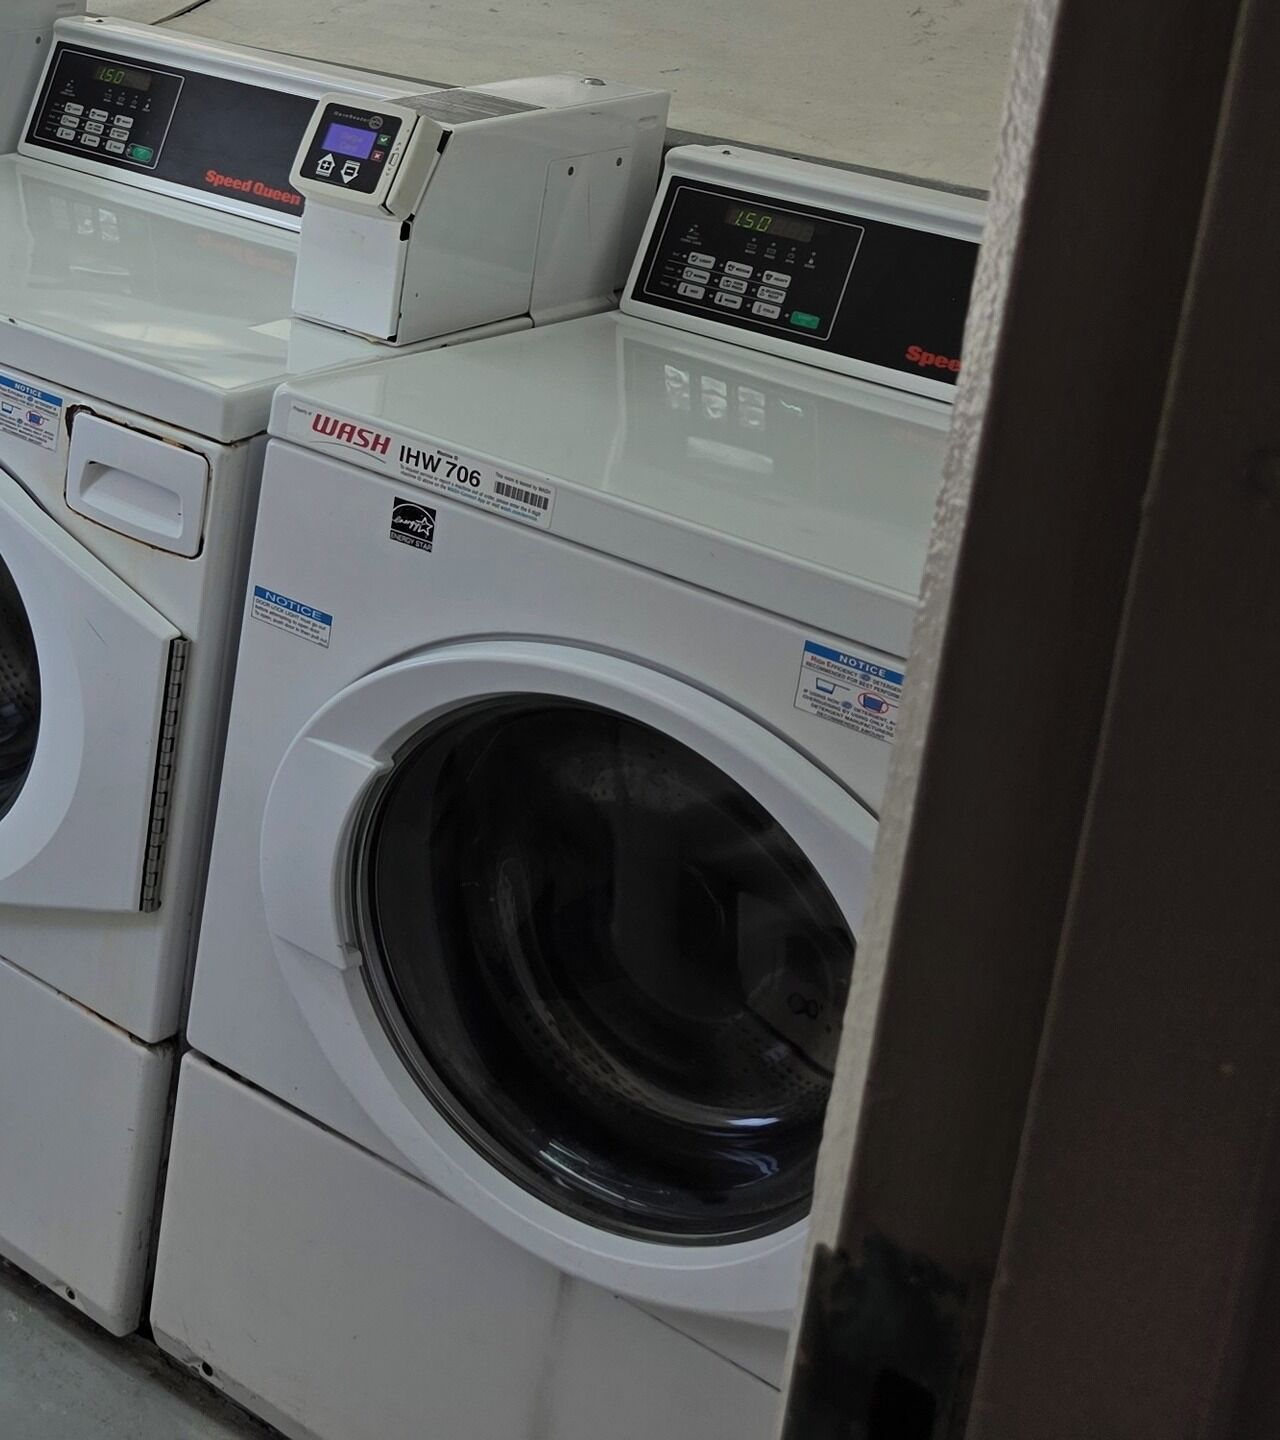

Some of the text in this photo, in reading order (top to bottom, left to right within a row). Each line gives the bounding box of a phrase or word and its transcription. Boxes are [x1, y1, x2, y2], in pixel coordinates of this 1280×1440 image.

[205, 169, 300, 205] Speed Queen
[15, 383, 43, 398] NOTICE
[311, 413, 391, 455] WASH
[399, 445, 442, 473] IHW
[445, 461, 482, 487] 706
[390, 531, 432, 551] ENERGY STAR
[265, 591, 322, 620] NOTICE
[840, 654, 887, 678] NOTICE
